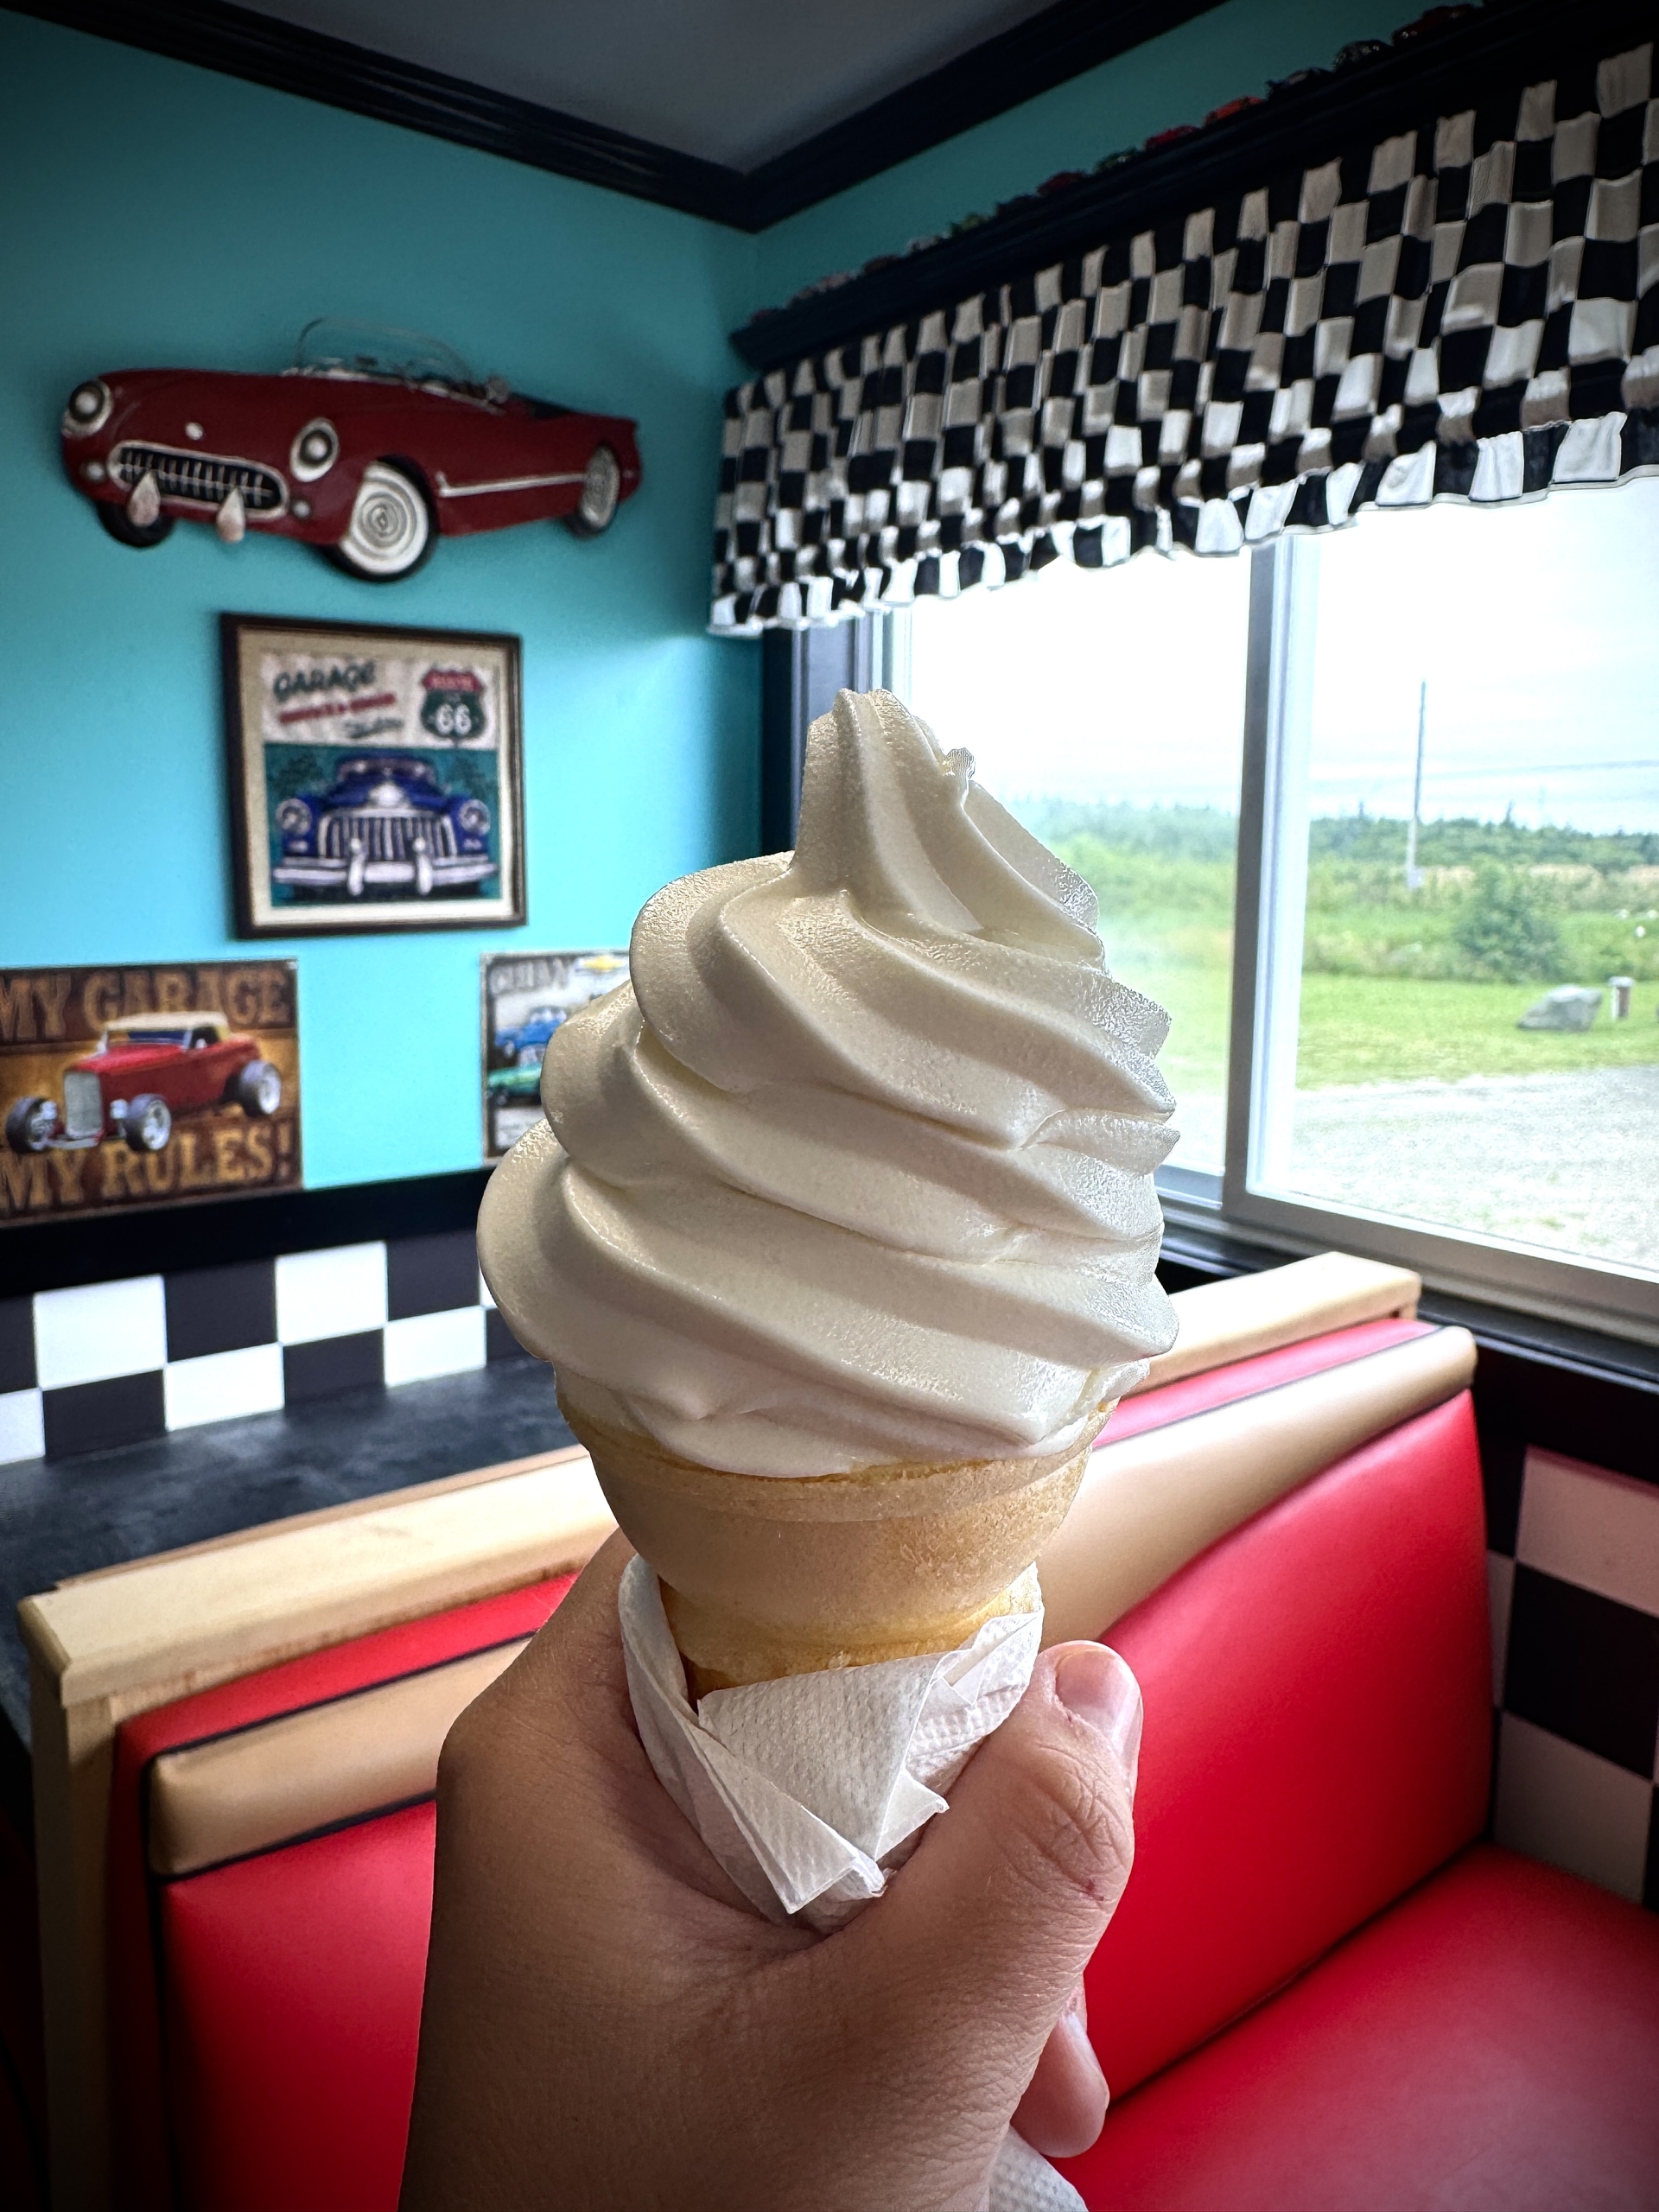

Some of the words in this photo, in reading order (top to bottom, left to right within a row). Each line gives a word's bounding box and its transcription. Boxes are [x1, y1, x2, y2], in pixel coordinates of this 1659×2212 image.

[272, 661, 377, 702] GARAGE
[435, 702, 474, 736] 66
[0, 973, 72, 1043] MY
[82, 967, 291, 1033] GARAGE
[0, 1149, 87, 1211] MY
[101, 1122, 293, 1201] RULES!
